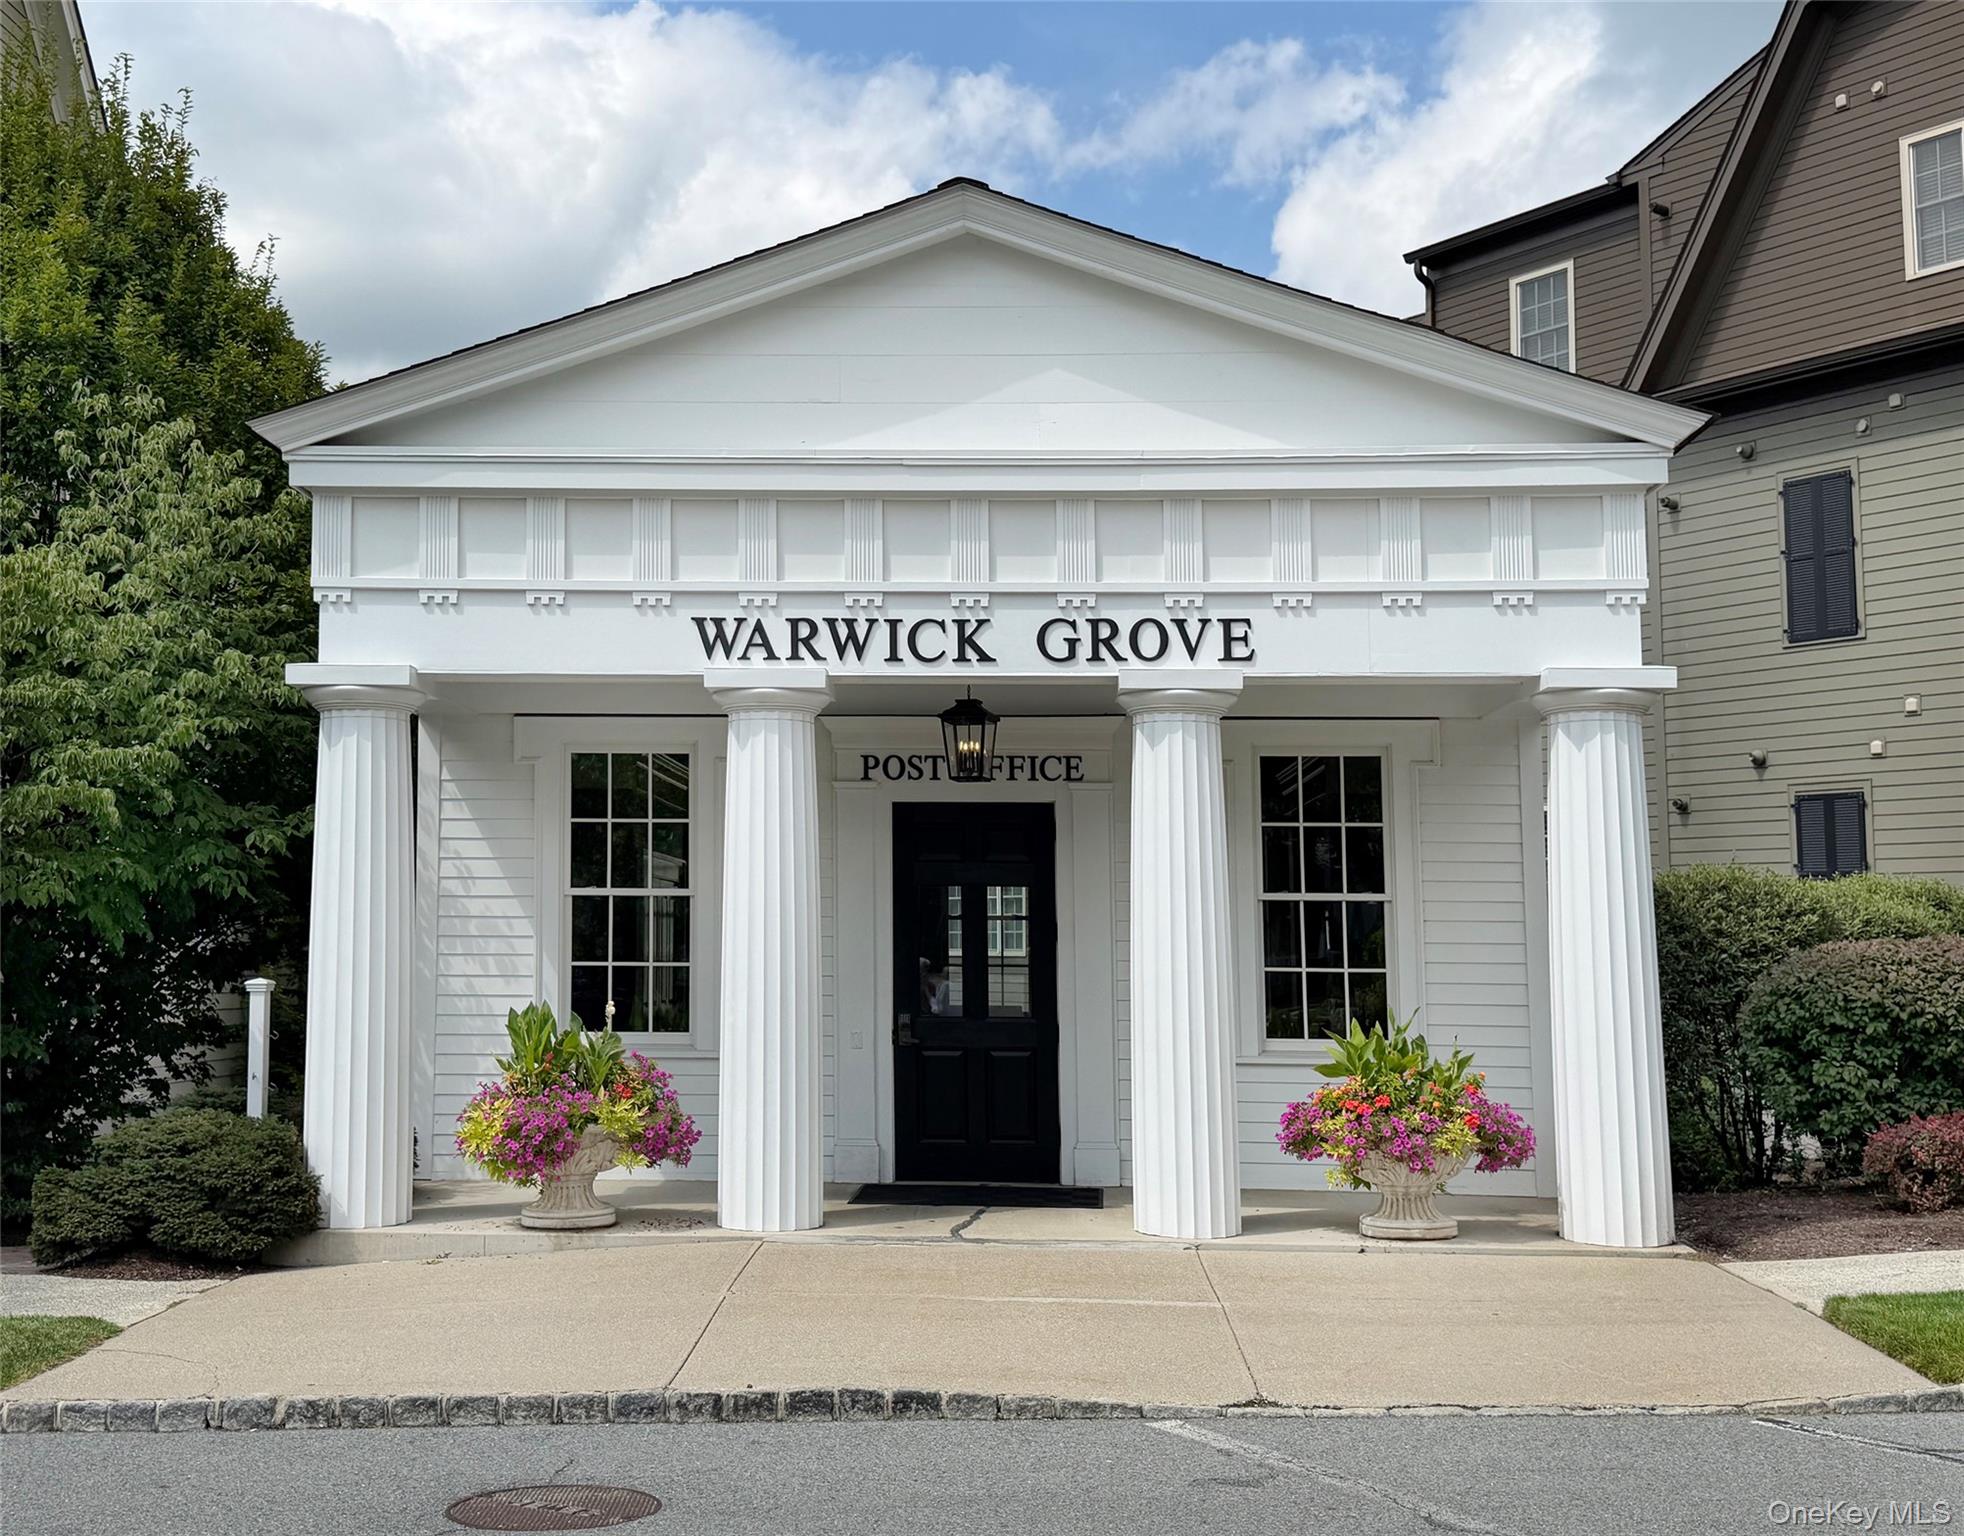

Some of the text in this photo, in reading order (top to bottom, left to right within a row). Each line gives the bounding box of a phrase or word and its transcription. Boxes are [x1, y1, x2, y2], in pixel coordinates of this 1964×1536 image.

[691, 617, 1255, 663] WARWICK GROVE
[860, 754, 1084, 782] POST FFICE
